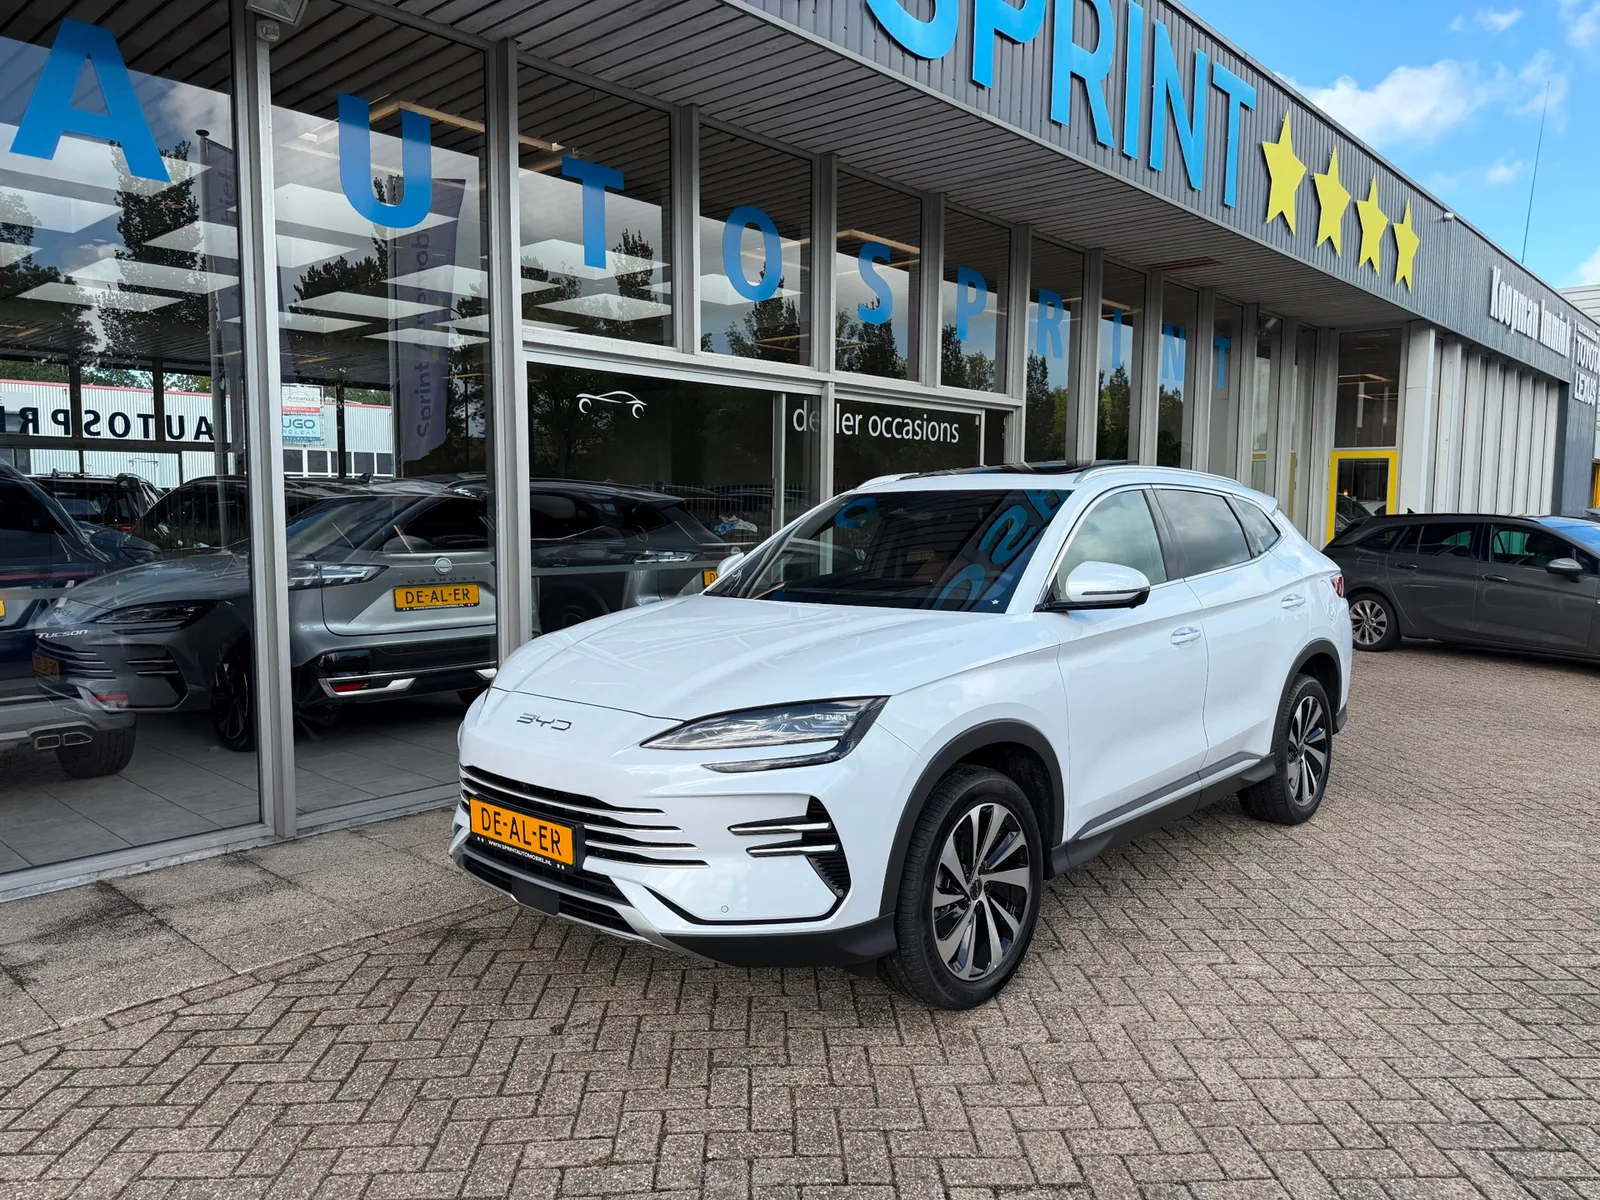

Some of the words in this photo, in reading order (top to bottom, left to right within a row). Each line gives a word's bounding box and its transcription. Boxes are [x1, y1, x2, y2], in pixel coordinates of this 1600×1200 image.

[1490, 265, 1540, 341] Koopman
[1577, 334, 1600, 375] TOYOT
[414, 360, 434, 438] Sprint
[1574, 370, 1597, 406] LEXUS
[793, 400, 863, 436] deler
[868, 404, 960, 444] occasions
[405, 588, 471, 605] DE-AL-ER
[516, 712, 573, 731] BYD
[481, 807, 562, 856] DE-AL-ER
